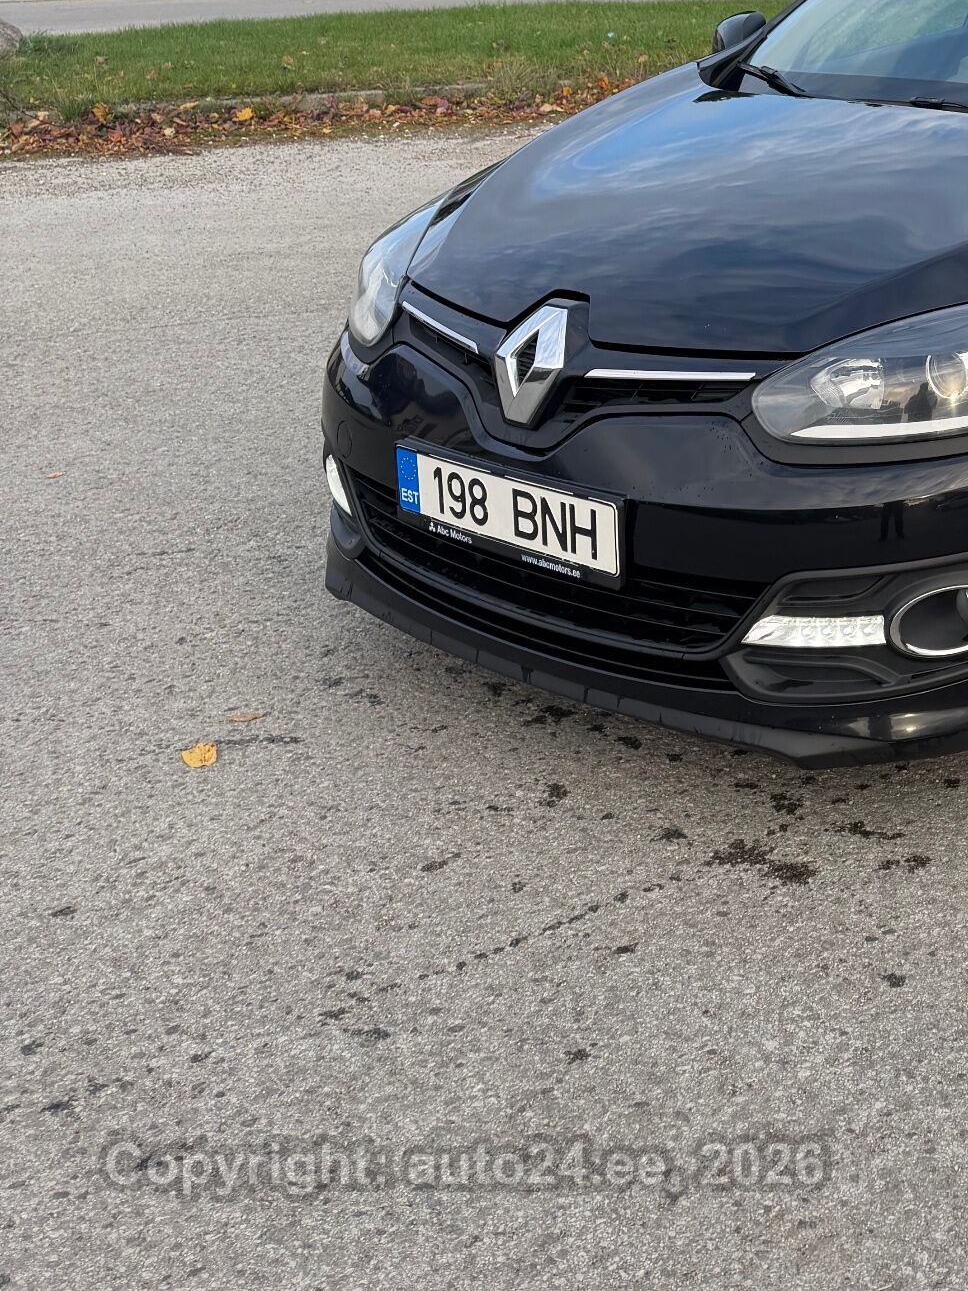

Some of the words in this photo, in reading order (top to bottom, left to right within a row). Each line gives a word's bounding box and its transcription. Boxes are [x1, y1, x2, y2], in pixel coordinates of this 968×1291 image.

[401, 487, 419, 505] EST
[433, 466, 489, 526] 198
[512, 488, 598, 561] BNH
[436, 524, 451, 538] Abc
[450, 528, 473, 545] Motors
[521, 553, 581, 579] www.abcmotors.ee
